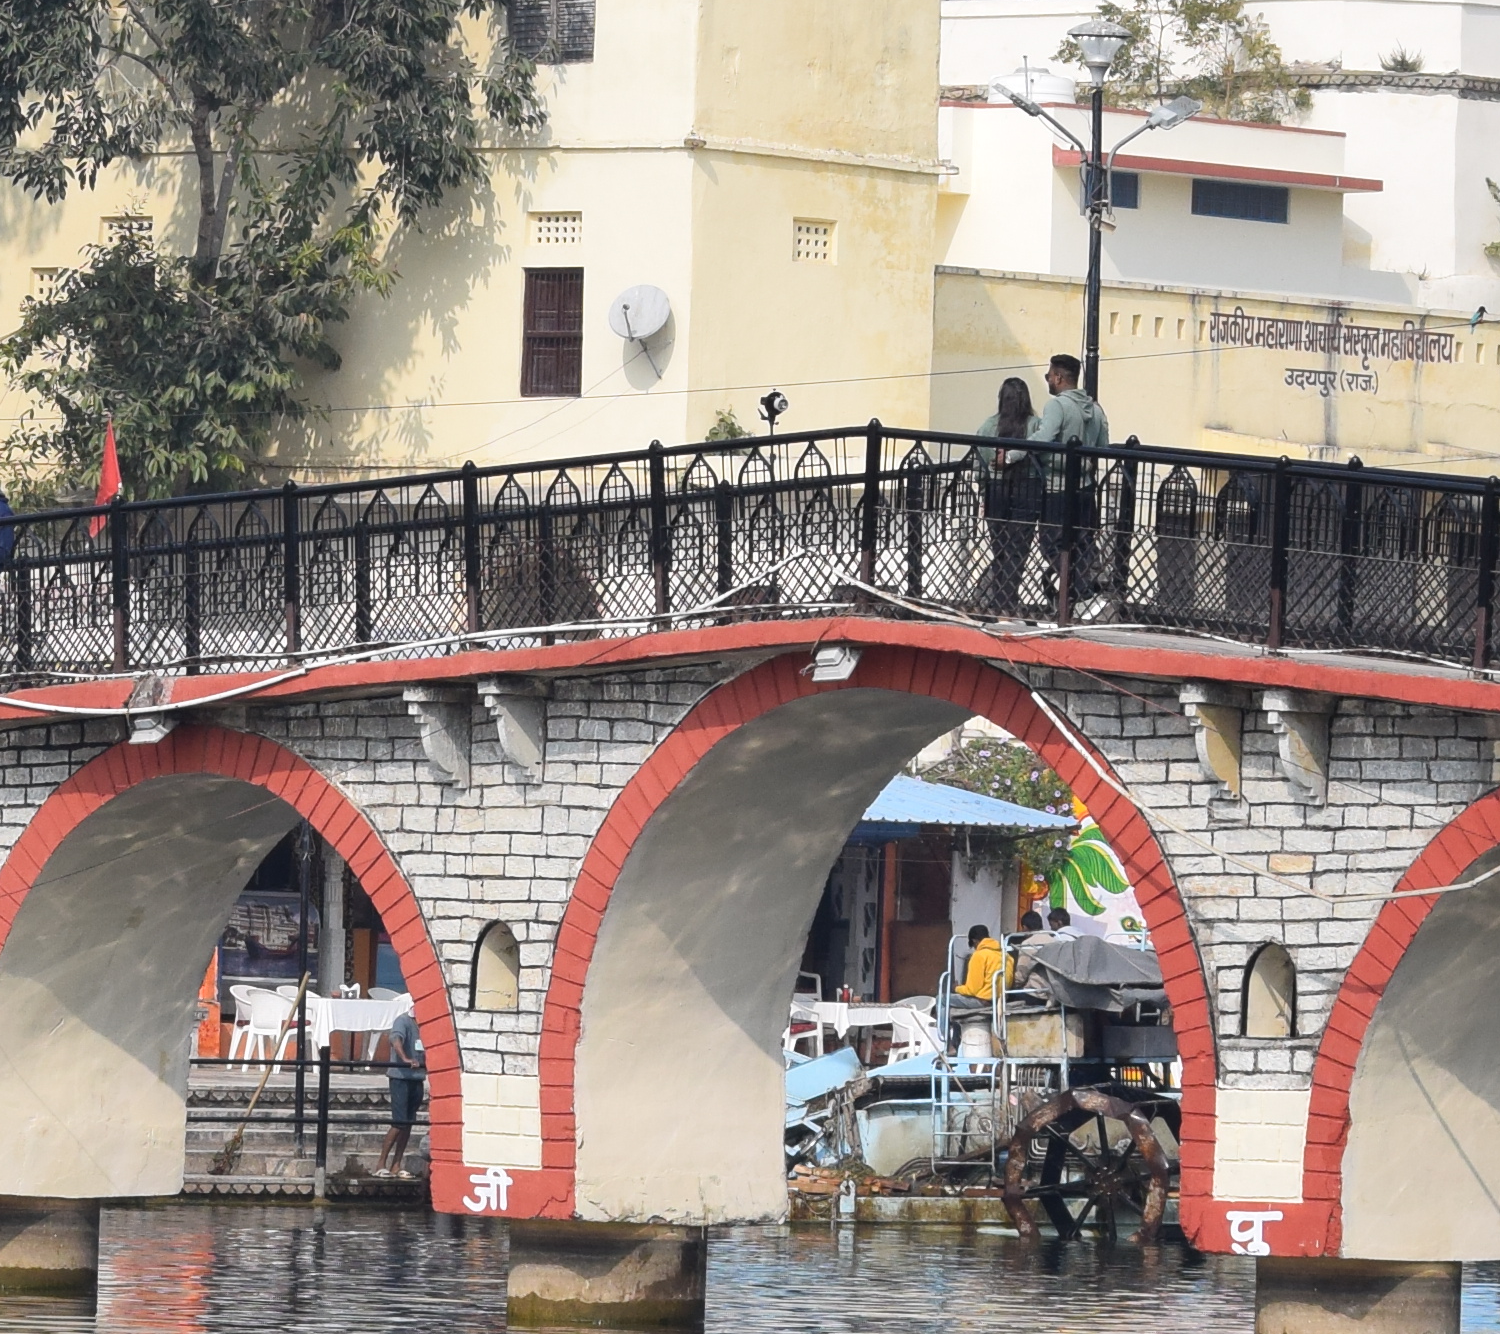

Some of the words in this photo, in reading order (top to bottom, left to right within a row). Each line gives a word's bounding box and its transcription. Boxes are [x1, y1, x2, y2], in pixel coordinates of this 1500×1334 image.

[1210, 305, 1255, 347] राजकीय
[1255, 317, 1304, 352] महाराणा
[1304, 313, 1343, 355] आचार्य
[1343, 317, 1379, 370] संस्कृत
[1380, 320, 1454, 363] महाविद्यालय
[1285, 368, 1337, 397] उदयपुर
[1340, 369, 1379, 395] (राज.)
[462, 1167, 513, 1212] जी
[1226, 1210, 1283, 1256] पु
